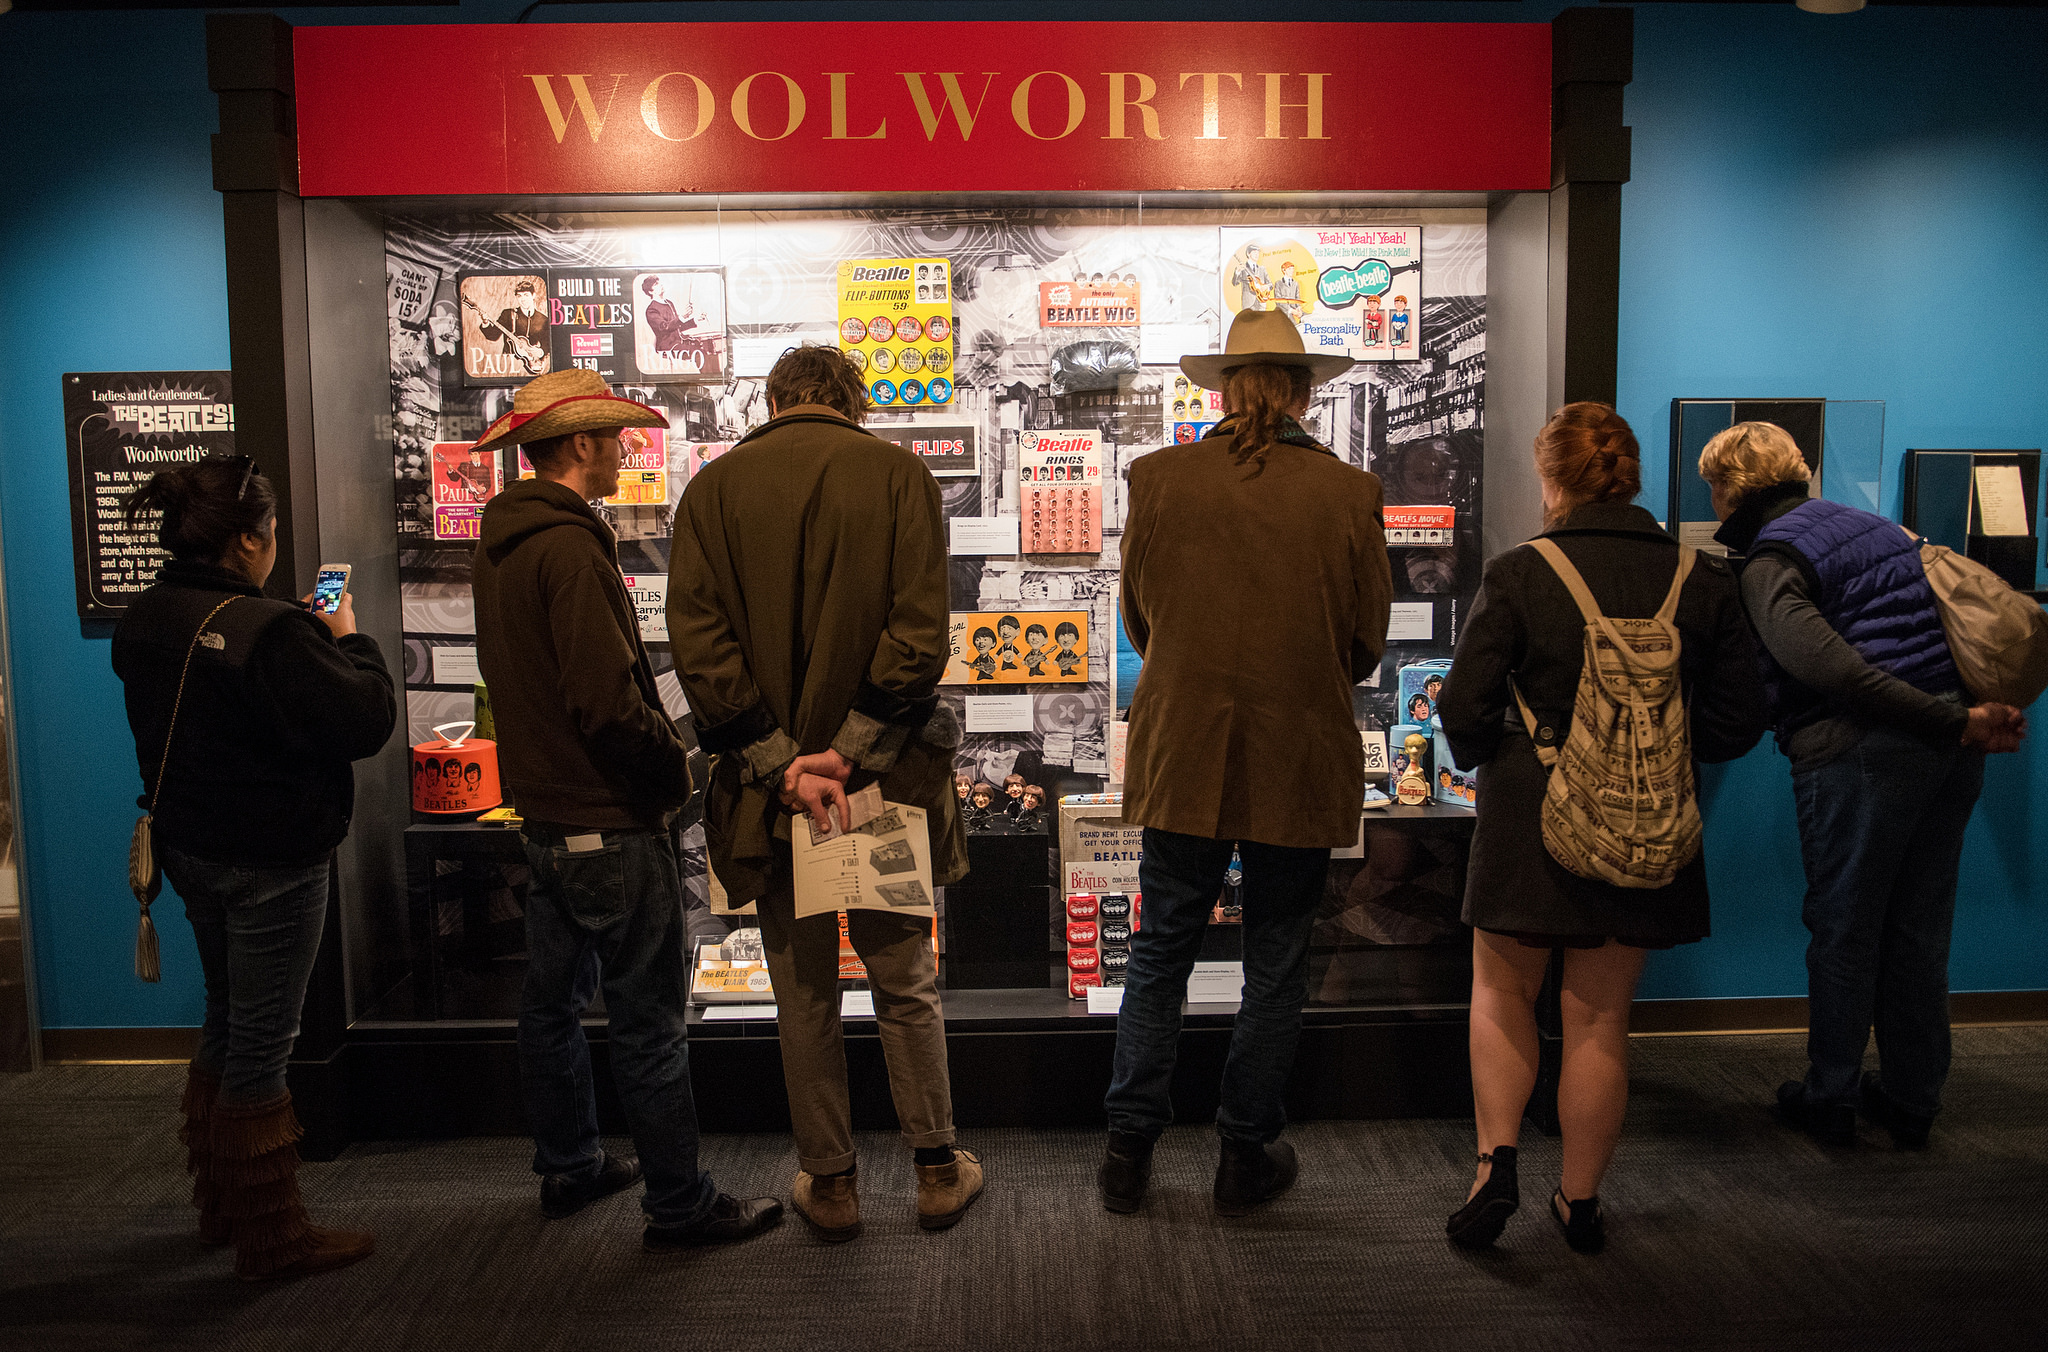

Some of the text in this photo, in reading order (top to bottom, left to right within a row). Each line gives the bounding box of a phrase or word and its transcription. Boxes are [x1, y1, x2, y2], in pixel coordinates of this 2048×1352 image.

[523, 71, 1332, 143] WOOLWORTH
[1317, 232, 1406, 245] Yeah! Yeah! Yeah!
[1377, 248, 1393, 257] Pink
[1393, 248, 1411, 257] Mild!
[401, 269, 428, 283] GIANT
[853, 266, 911, 282] Beatle
[396, 278, 417, 289] DOUBLE
[558, 278, 622, 297] BUILD THE
[1322, 265, 1389, 297] beatle-beatle
[394, 287, 423, 304] SODA
[845, 289, 911, 302] FLIP-BUTTONS
[1102, 290, 1116, 298] only
[1079, 297, 1129, 307] AUTHENTIC
[549, 298, 633, 329] BEATLES
[1047, 306, 1137, 322] BEATLE WIG
[1303, 323, 1361, 336] Personality
[576, 336, 600, 347] Revell
[1319, 334, 1344, 346] Bath
[470, 347, 521, 374] PAUL
[640, 343, 705, 371] RINGO
[92, 388, 210, 402] Ladies and Gentlemen...
[112, 403, 236, 433] THE BEATLES!
[912, 439, 965, 456] FLIPS
[1036, 437, 1093, 452] Beatle
[123, 444, 209, 463] Woolworth's
[1045, 455, 1085, 465] RINGS
[620, 452, 661, 469] EORGE
[94, 471, 111, 482] The
[113, 471, 130, 481] F.W.
[438, 483, 473, 502] PAUL
[96, 497, 120, 507] 1960s
[1383, 515, 1445, 523] BEATLES MOVIE
[114, 522, 123, 531] of
[99, 533, 160, 546] the height of Be
[99, 546, 122, 557] store,
[122, 545, 146, 555] which
[100, 558, 164, 570] and city in Am
[101, 570, 158, 583] array of Beat
[102, 585, 118, 593] was
[118, 583, 140, 593] often
[629, 591, 662, 605] ATLES
[638, 614, 650, 622] se
[949, 622, 966, 634] CIAL
[1398, 785, 1426, 797] BEATLES
[424, 797, 468, 811] BEATLES
[1102, 830, 1118, 838] NEW!
[1122, 830, 1143, 838] EXCLU
[1094, 851, 1143, 862] BEATLE
[1071, 871, 1108, 890] BEATLES
[715, 969, 749, 978] BEATLES
[723, 978, 768, 986] DIARY 1965
